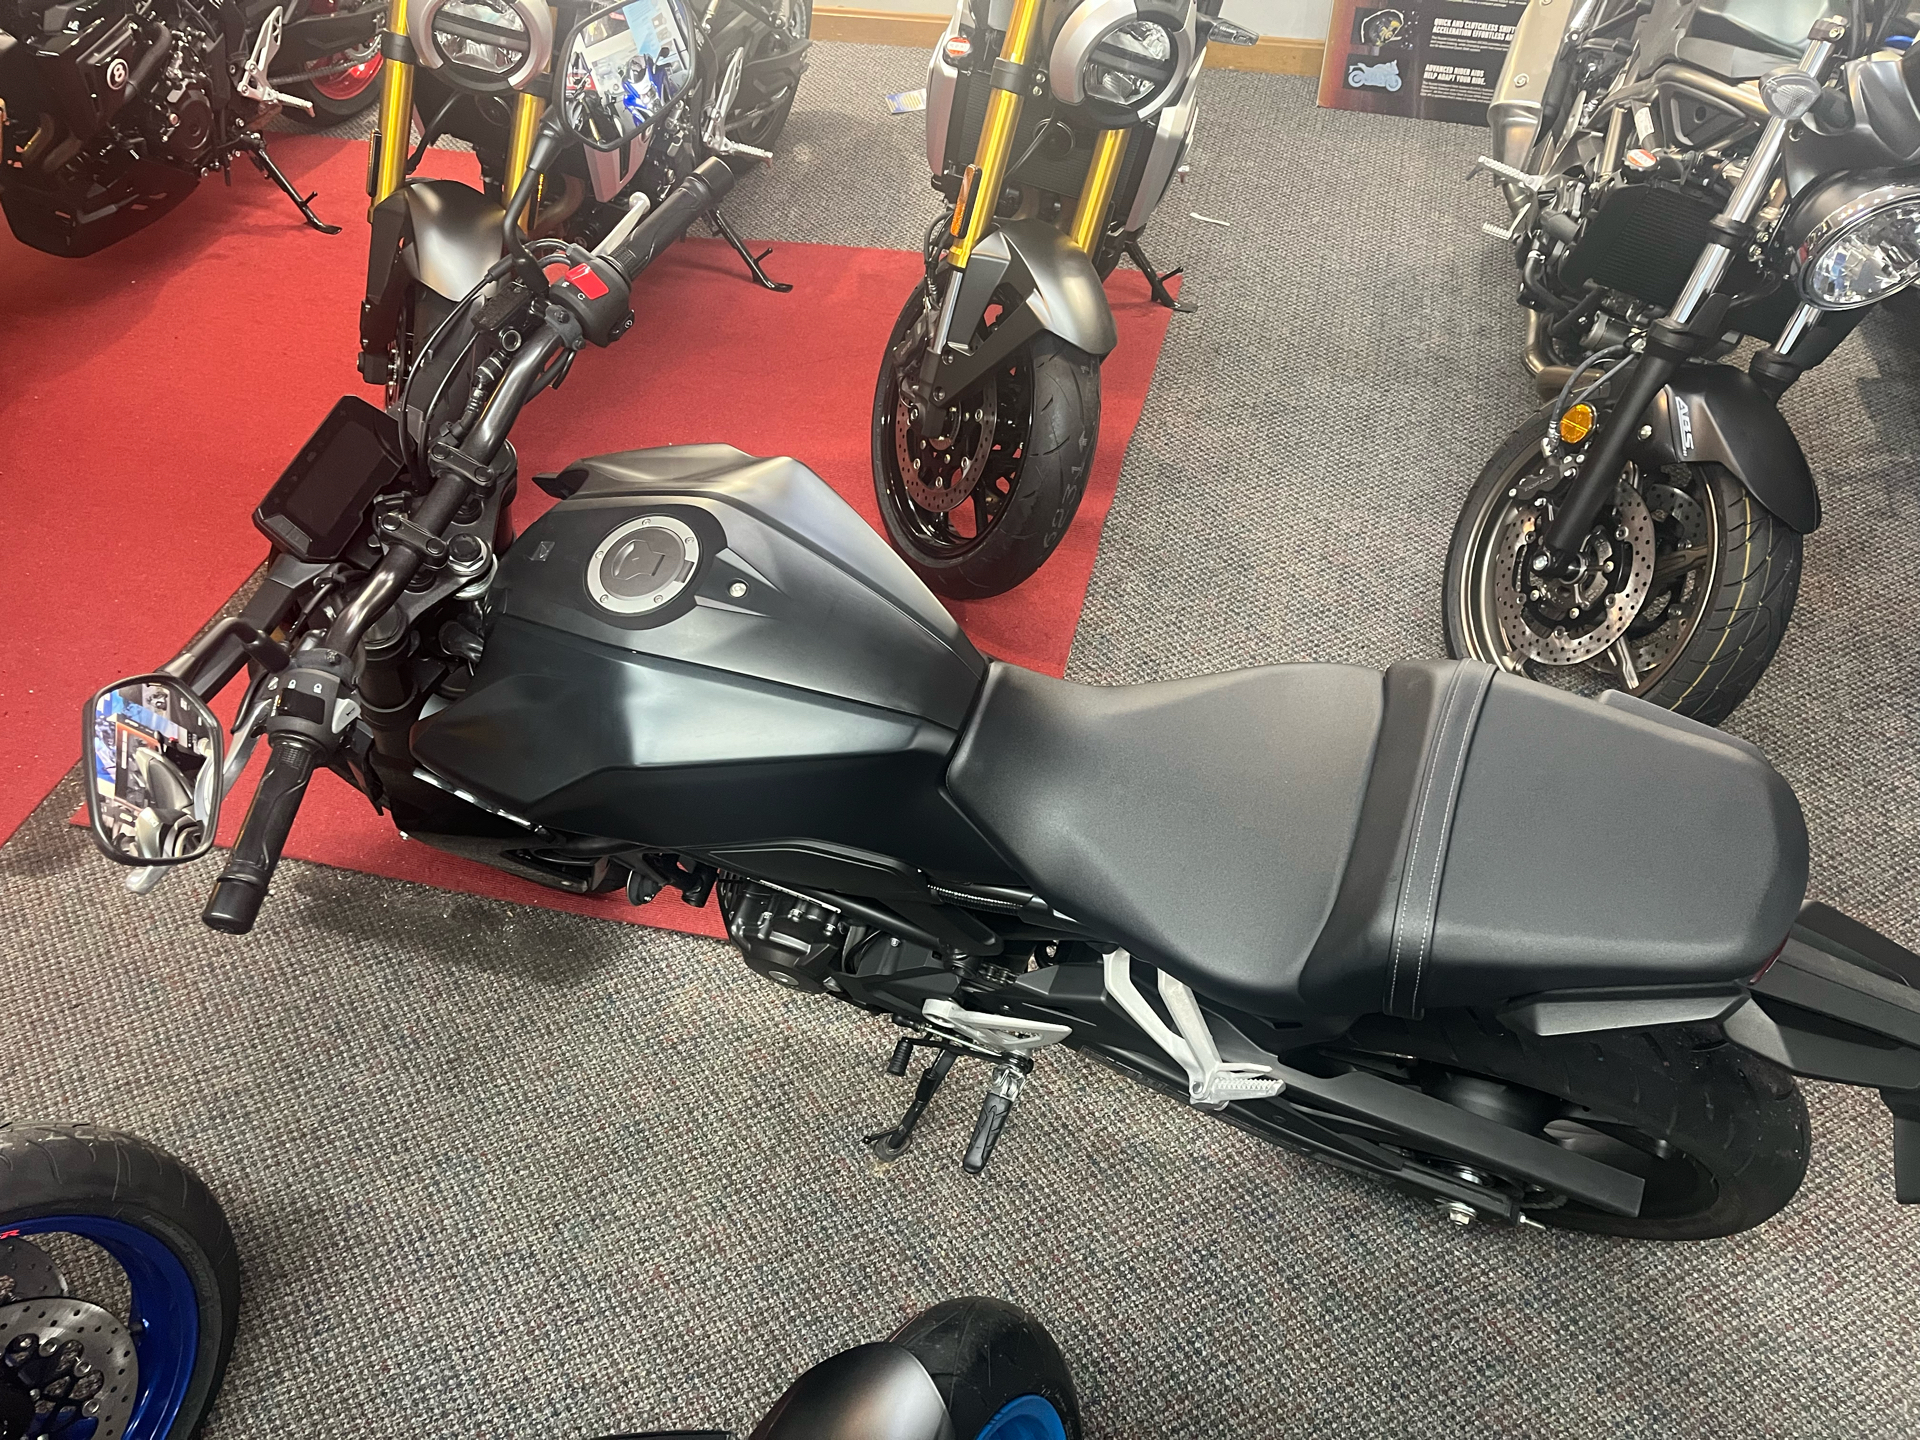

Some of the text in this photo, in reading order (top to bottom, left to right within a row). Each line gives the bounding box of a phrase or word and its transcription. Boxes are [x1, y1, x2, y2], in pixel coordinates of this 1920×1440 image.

[1434, 18, 1452, 26] QUICK
[1453, 20, 1464, 28] AND
[1465, 21, 1498, 32] CLUTCHLESS
[1432, 26, 1472, 36] ACCELERATION
[1473, 30, 1505, 40] EFFORTLESS
[1425, 64, 1485, 77] ADVANCED RIDER AIDS
[1437, 73, 1456, 82] ADAPT
[1457, 75, 1471, 83] YOUR
[1472, 77, 1486, 85] RIDE.
[1675, 396, 1695, 450] ABS
